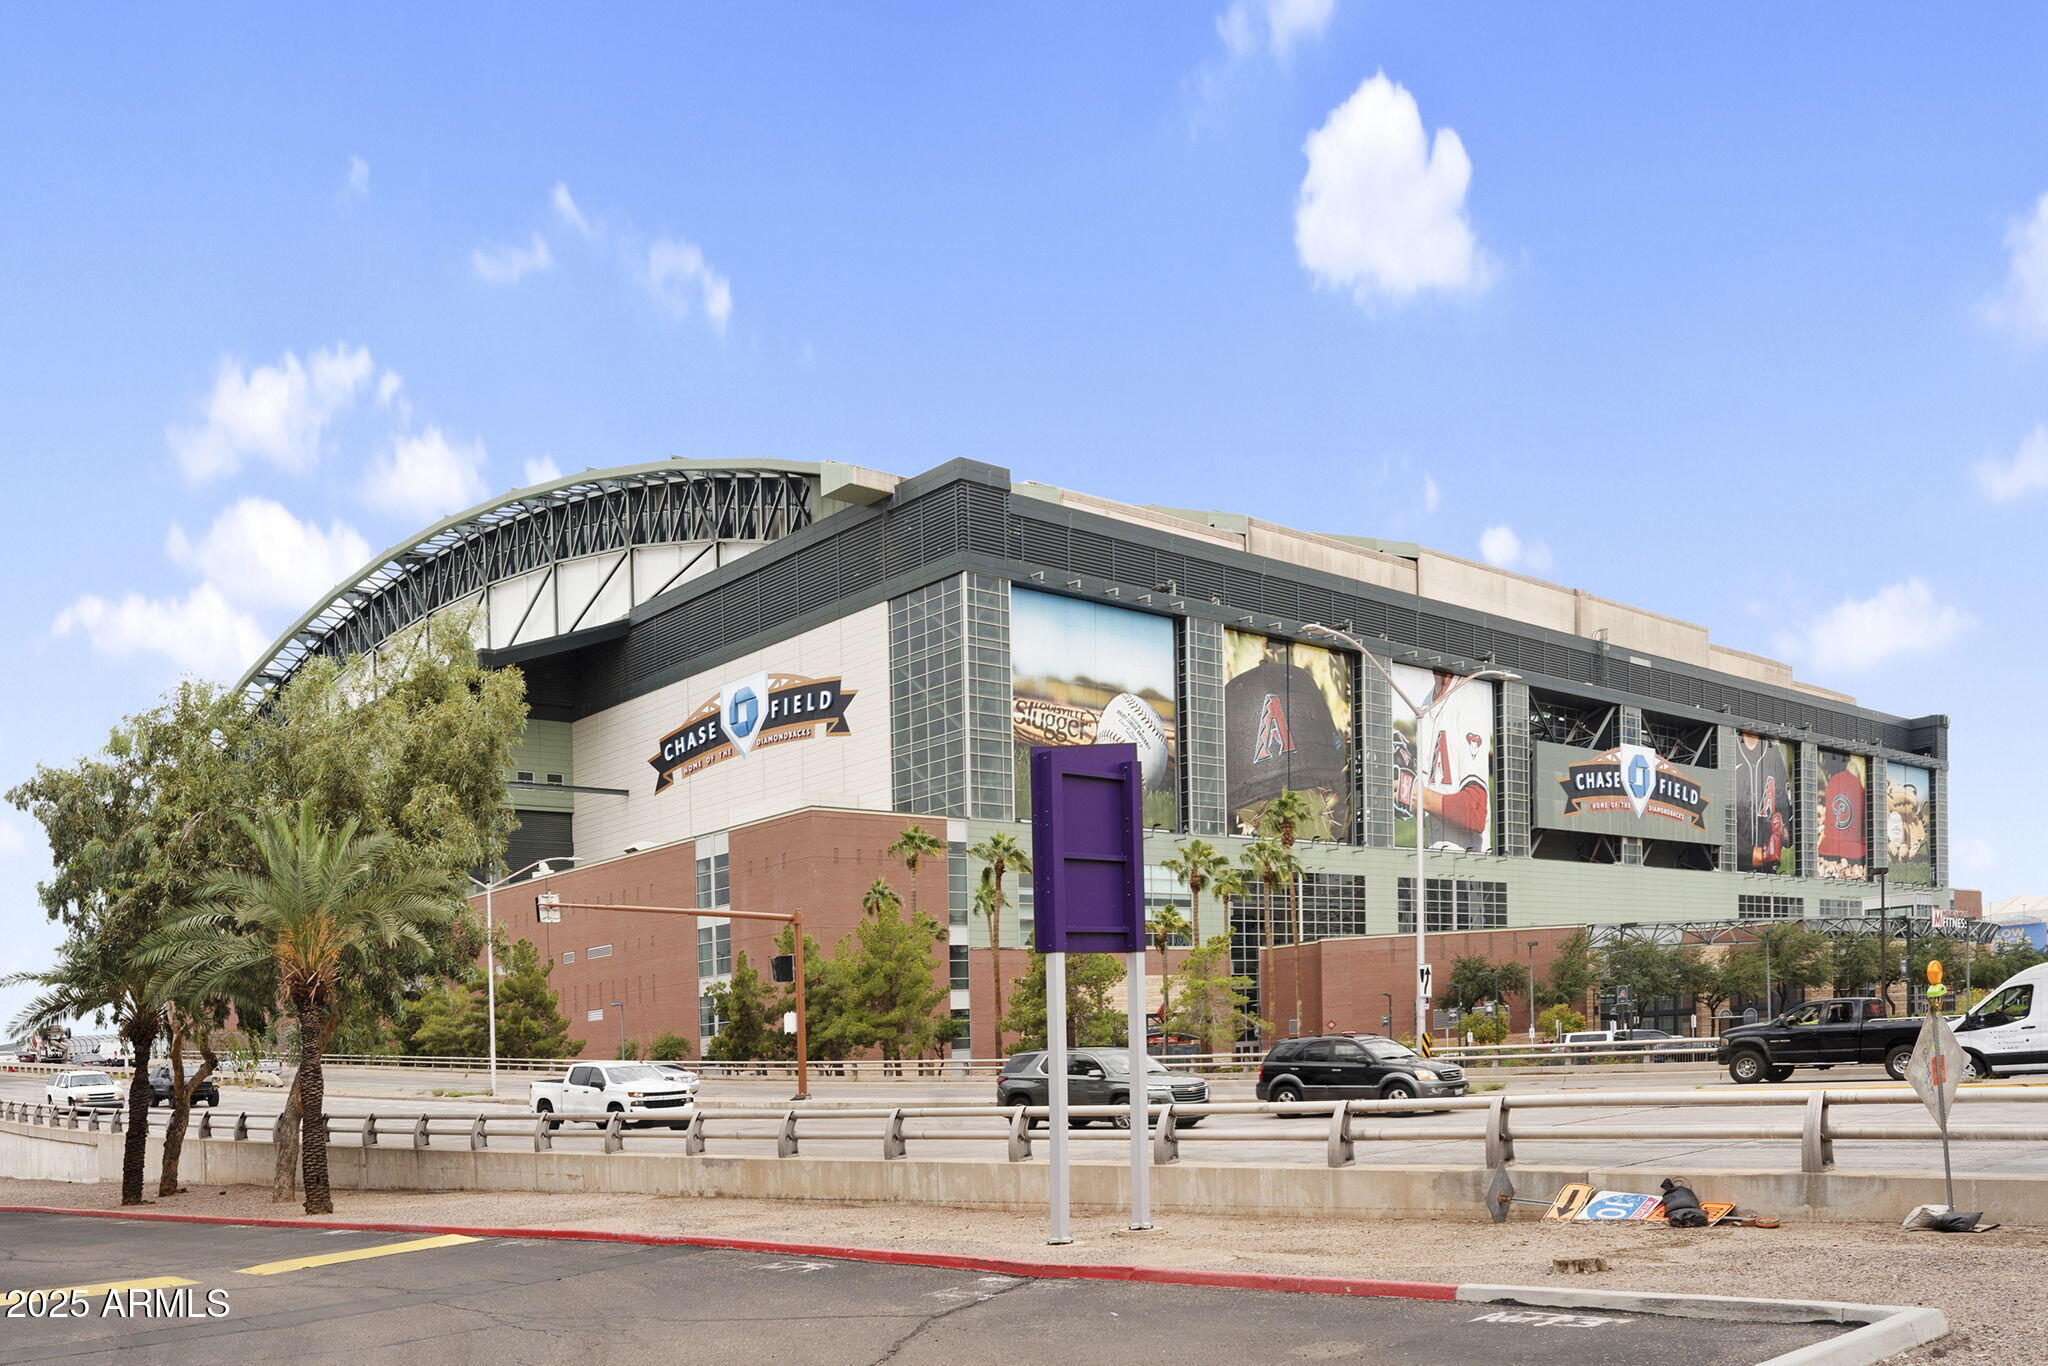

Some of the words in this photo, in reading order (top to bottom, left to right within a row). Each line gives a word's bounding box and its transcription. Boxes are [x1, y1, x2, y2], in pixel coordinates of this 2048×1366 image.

[1014, 700, 1087, 742] Slugger
[1033, 702, 1085, 721] LOUISVILLE
[664, 721, 718, 762] CHASE
[771, 690, 834, 719] FIELD
[683, 760, 703, 775] HOME
[706, 754, 716, 765] OF
[719, 748, 733, 760] THE
[756, 728, 812, 747] DIAMONDBACKS
[1575, 772, 1621, 790] CHASE
[1658, 778, 1699, 805] FIELD
[1591, 802, 1608, 810] HOME
[1647, 804, 1685, 820] DIAMONDBACKS
[1943, 916, 1968, 929] FITNESS
[1994, 928, 2025, 938] LOW
[1595, 1199, 1634, 1220] 10
